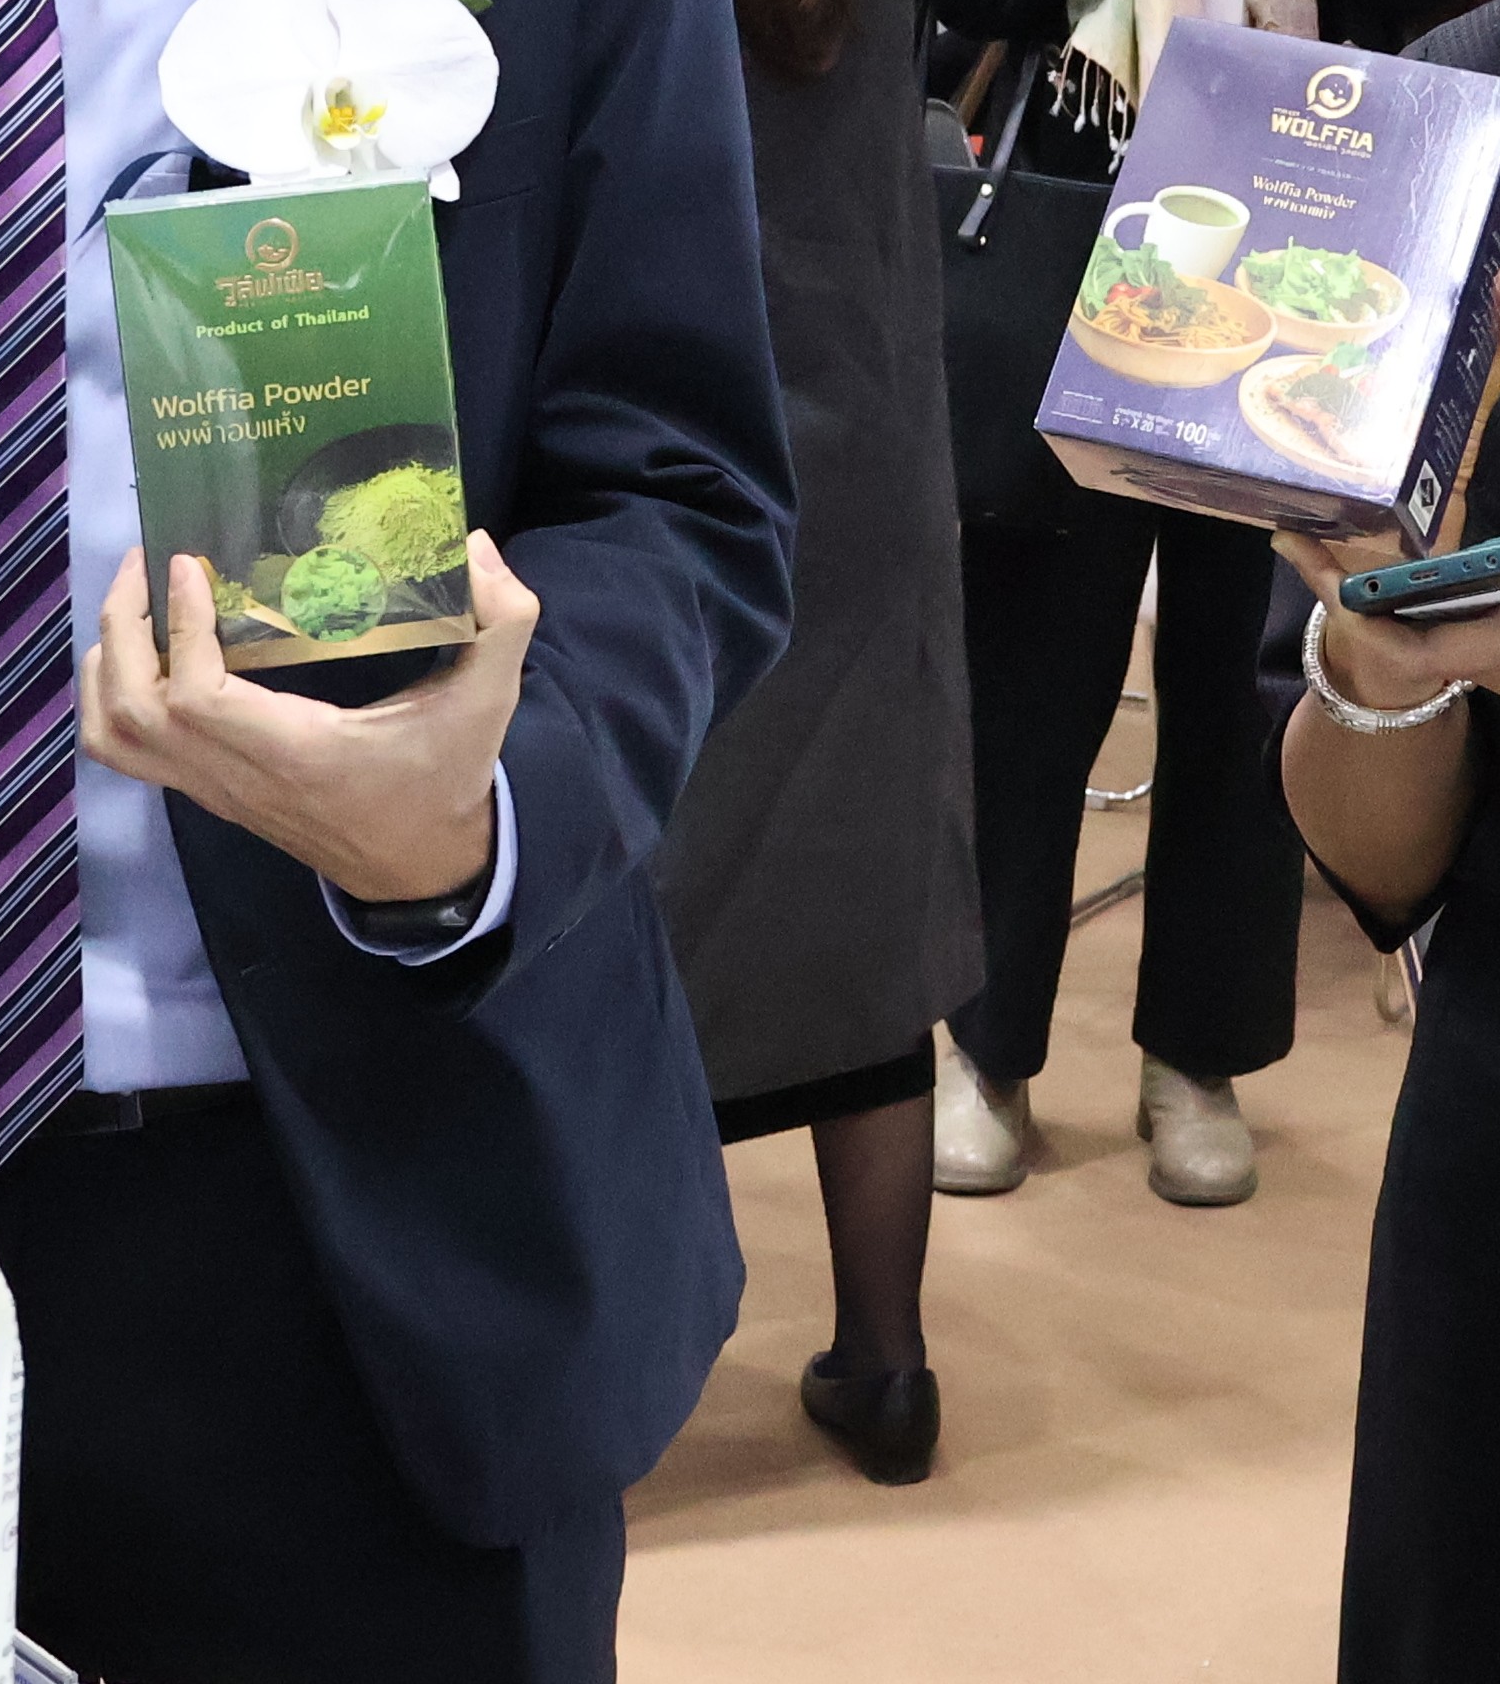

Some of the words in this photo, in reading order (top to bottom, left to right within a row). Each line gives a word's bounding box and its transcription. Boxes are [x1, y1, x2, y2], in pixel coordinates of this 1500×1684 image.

[1270, 113, 1374, 153] WOLFFIA
[195, 319, 264, 339] Product
[270, 314, 289, 330] of
[294, 304, 371, 328] Thailand
[151, 387, 255, 420] Wolffia
[264, 374, 372, 408] Powder
